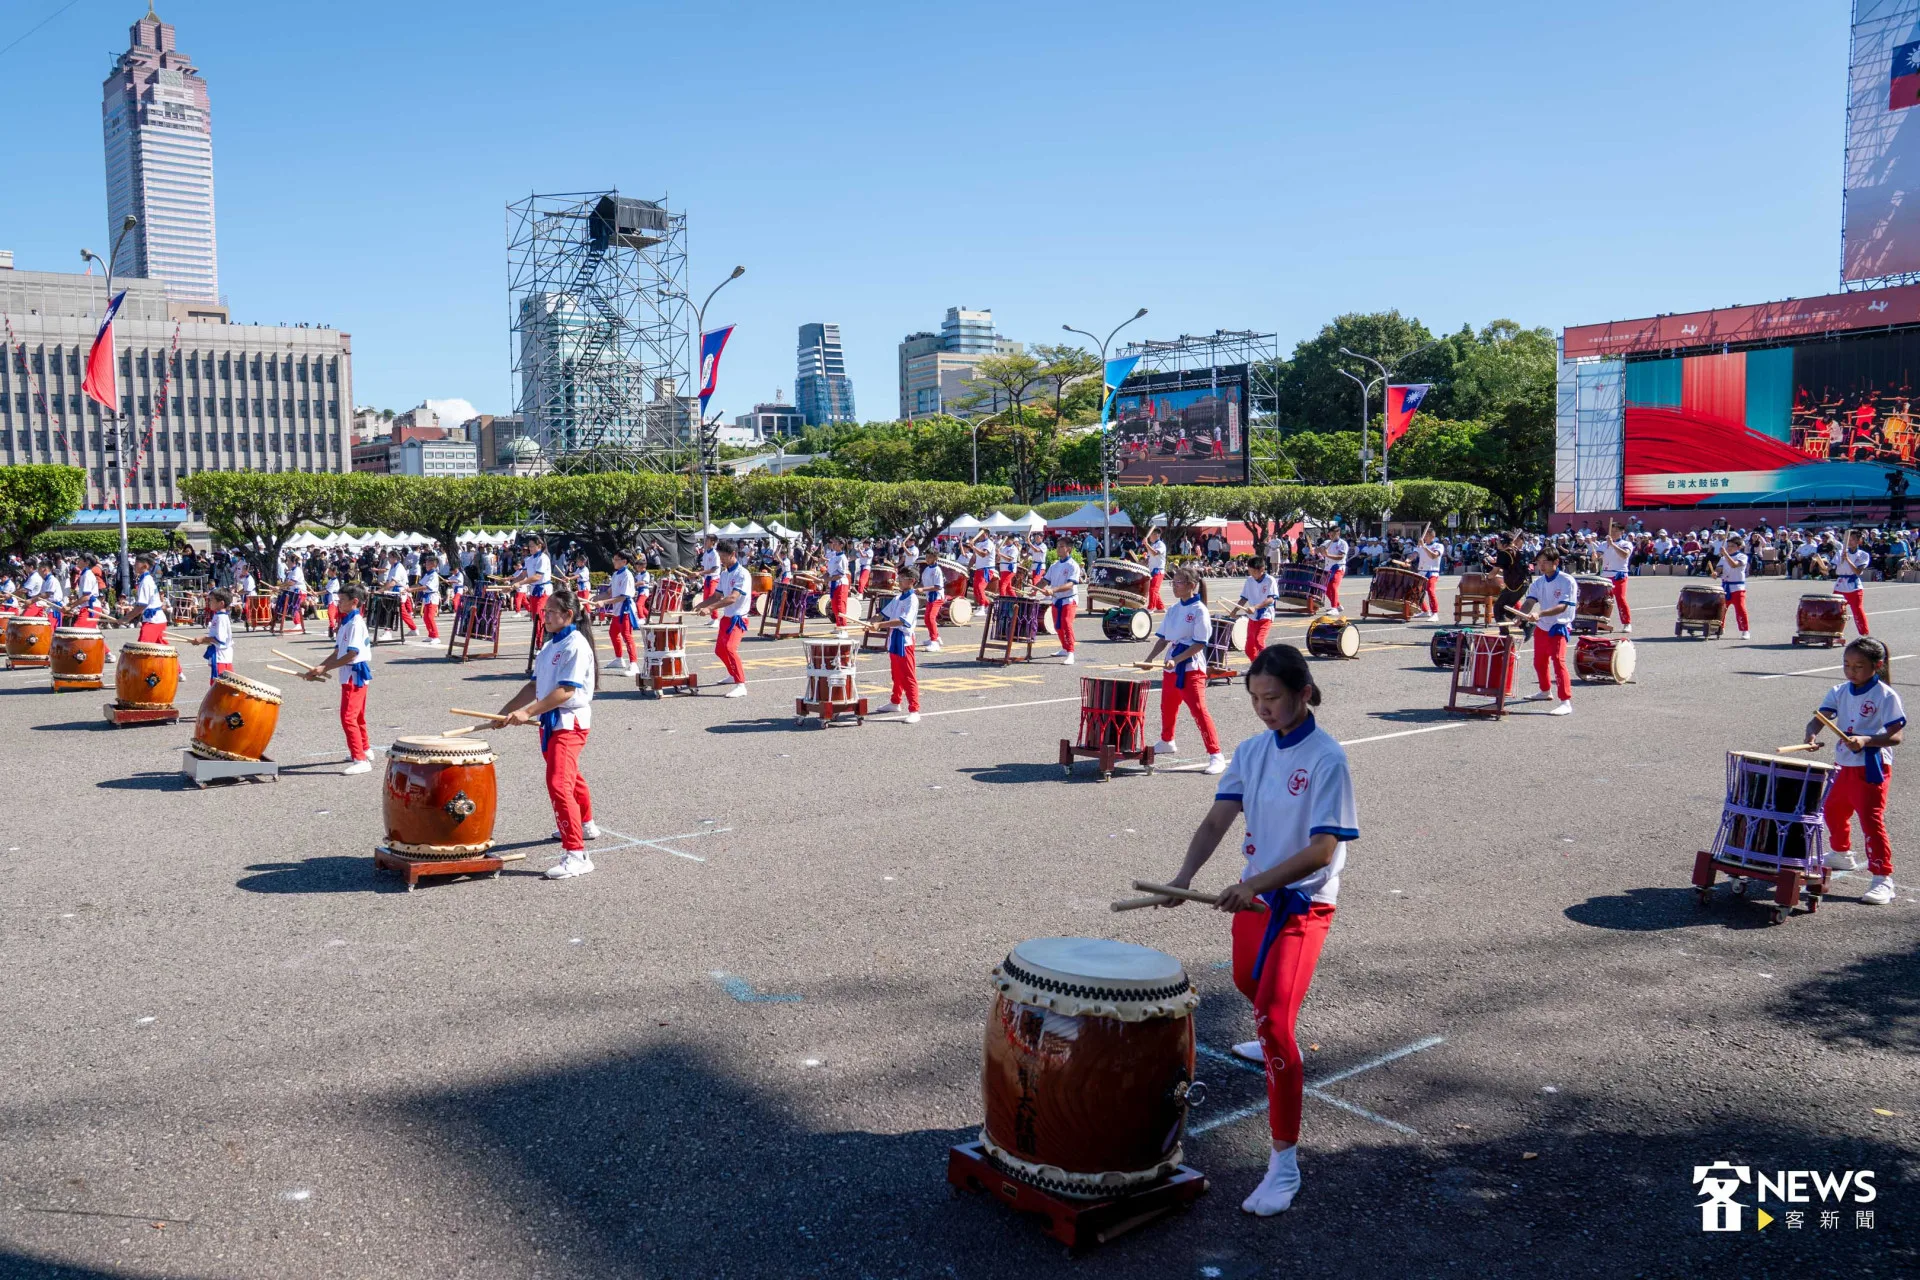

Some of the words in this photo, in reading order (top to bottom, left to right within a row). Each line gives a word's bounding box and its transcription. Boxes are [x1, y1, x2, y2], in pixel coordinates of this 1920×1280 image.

[1667, 477, 1729, 489] 台灣太鼓協會
